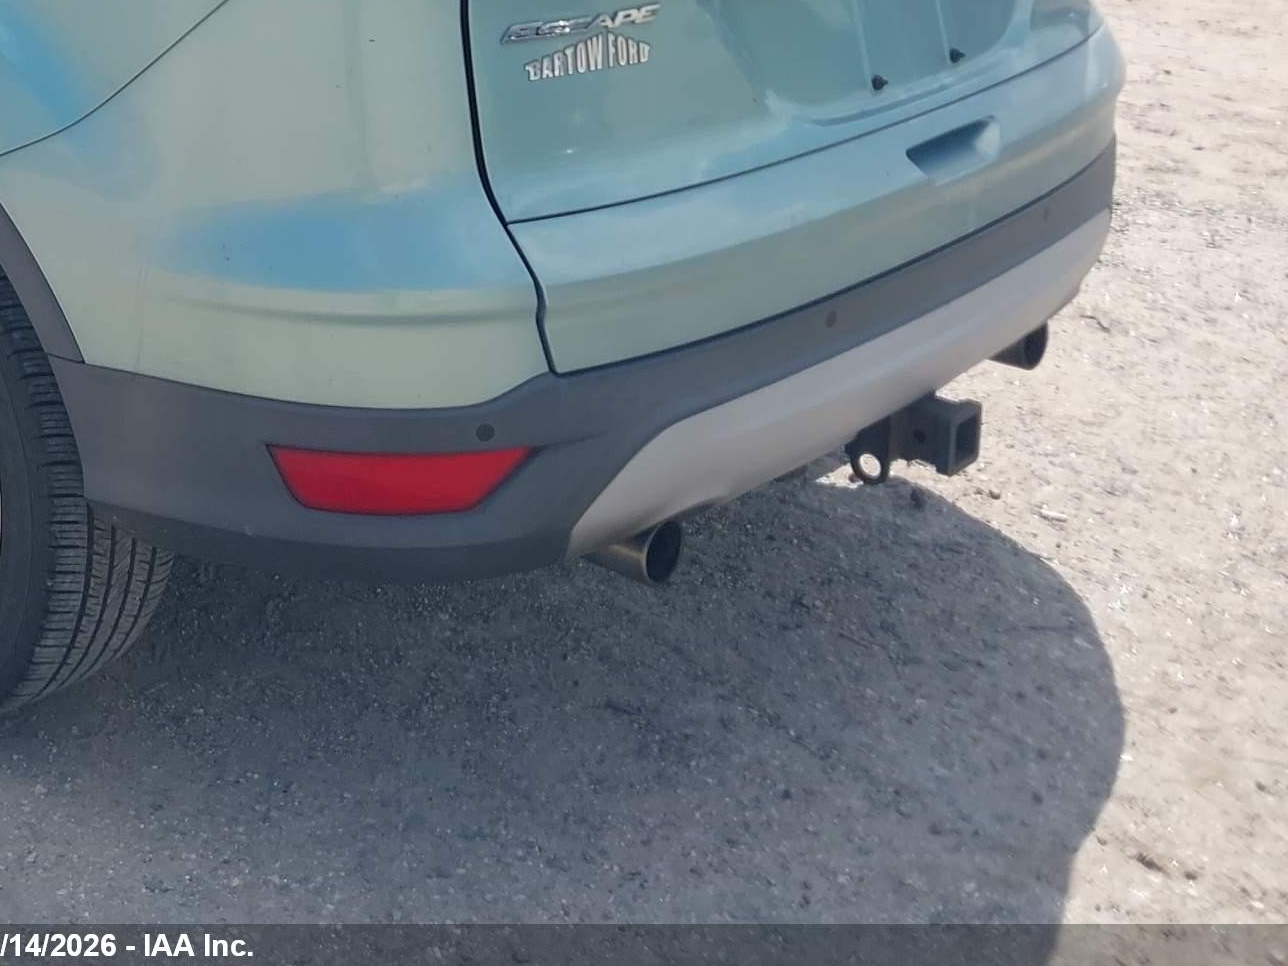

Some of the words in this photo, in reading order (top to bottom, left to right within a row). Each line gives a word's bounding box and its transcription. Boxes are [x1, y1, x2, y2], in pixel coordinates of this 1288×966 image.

[500, 1, 661, 45] ESCAPE
[524, 33, 604, 81] BARTOW
[607, 32, 651, 68] FORD
